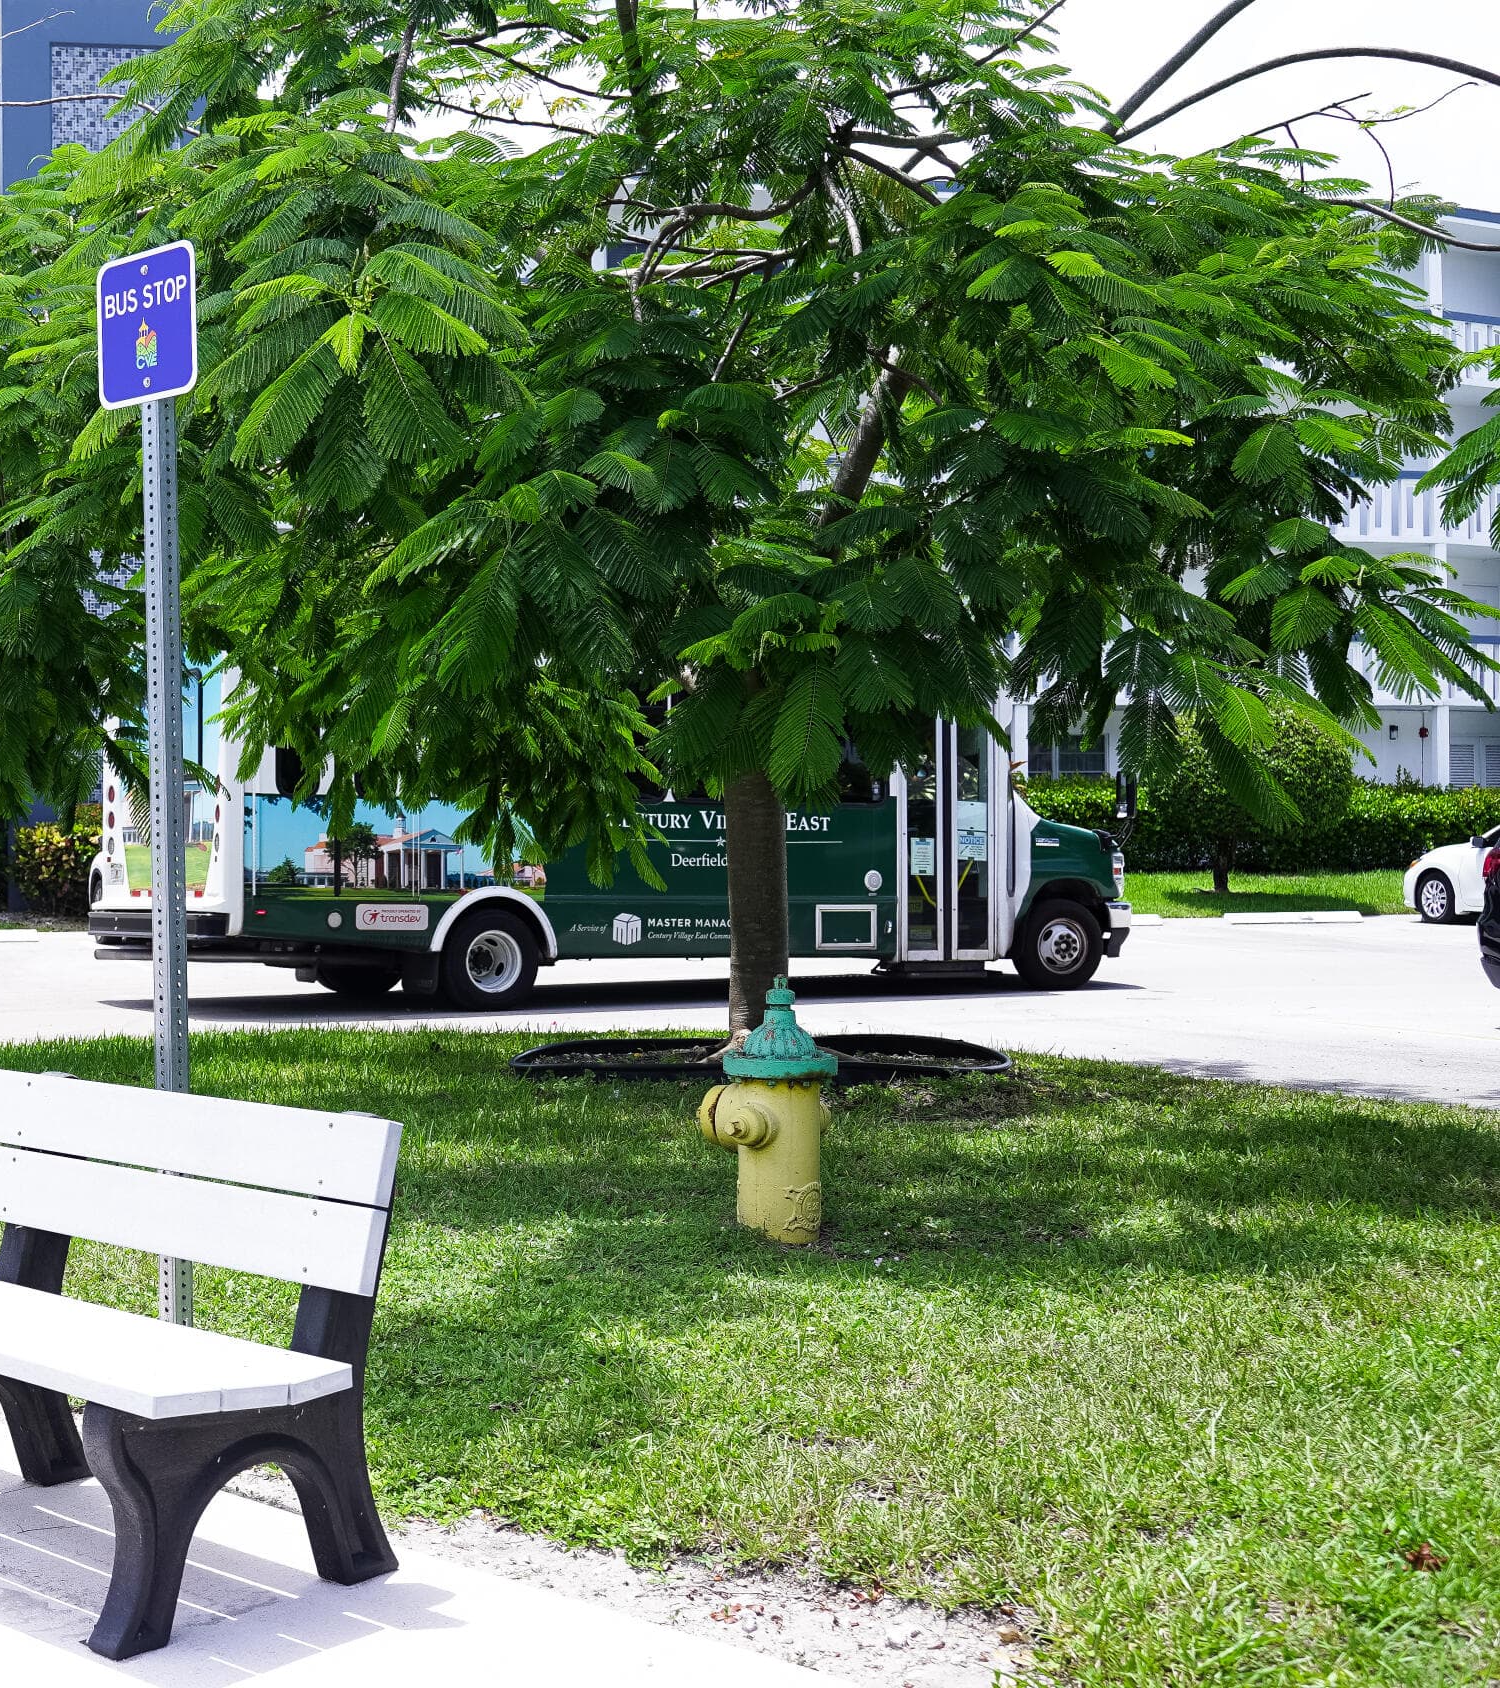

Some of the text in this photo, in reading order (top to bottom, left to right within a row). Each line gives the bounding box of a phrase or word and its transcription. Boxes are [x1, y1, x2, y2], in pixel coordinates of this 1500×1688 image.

[104, 275, 187, 320] BUS STOP
[136, 353, 158, 370] CVE
[959, 836, 985, 845] NOTICE
[671, 853, 728, 867] Deerfield
[380, 914, 421, 923] transdev
[648, 918, 691, 928] MASTER
[577, 924, 598, 932] Service
[599, 924, 608, 935] of
[648, 931, 672, 942] Century
[673, 931, 694, 942] Village
[695, 931, 709, 940] East
